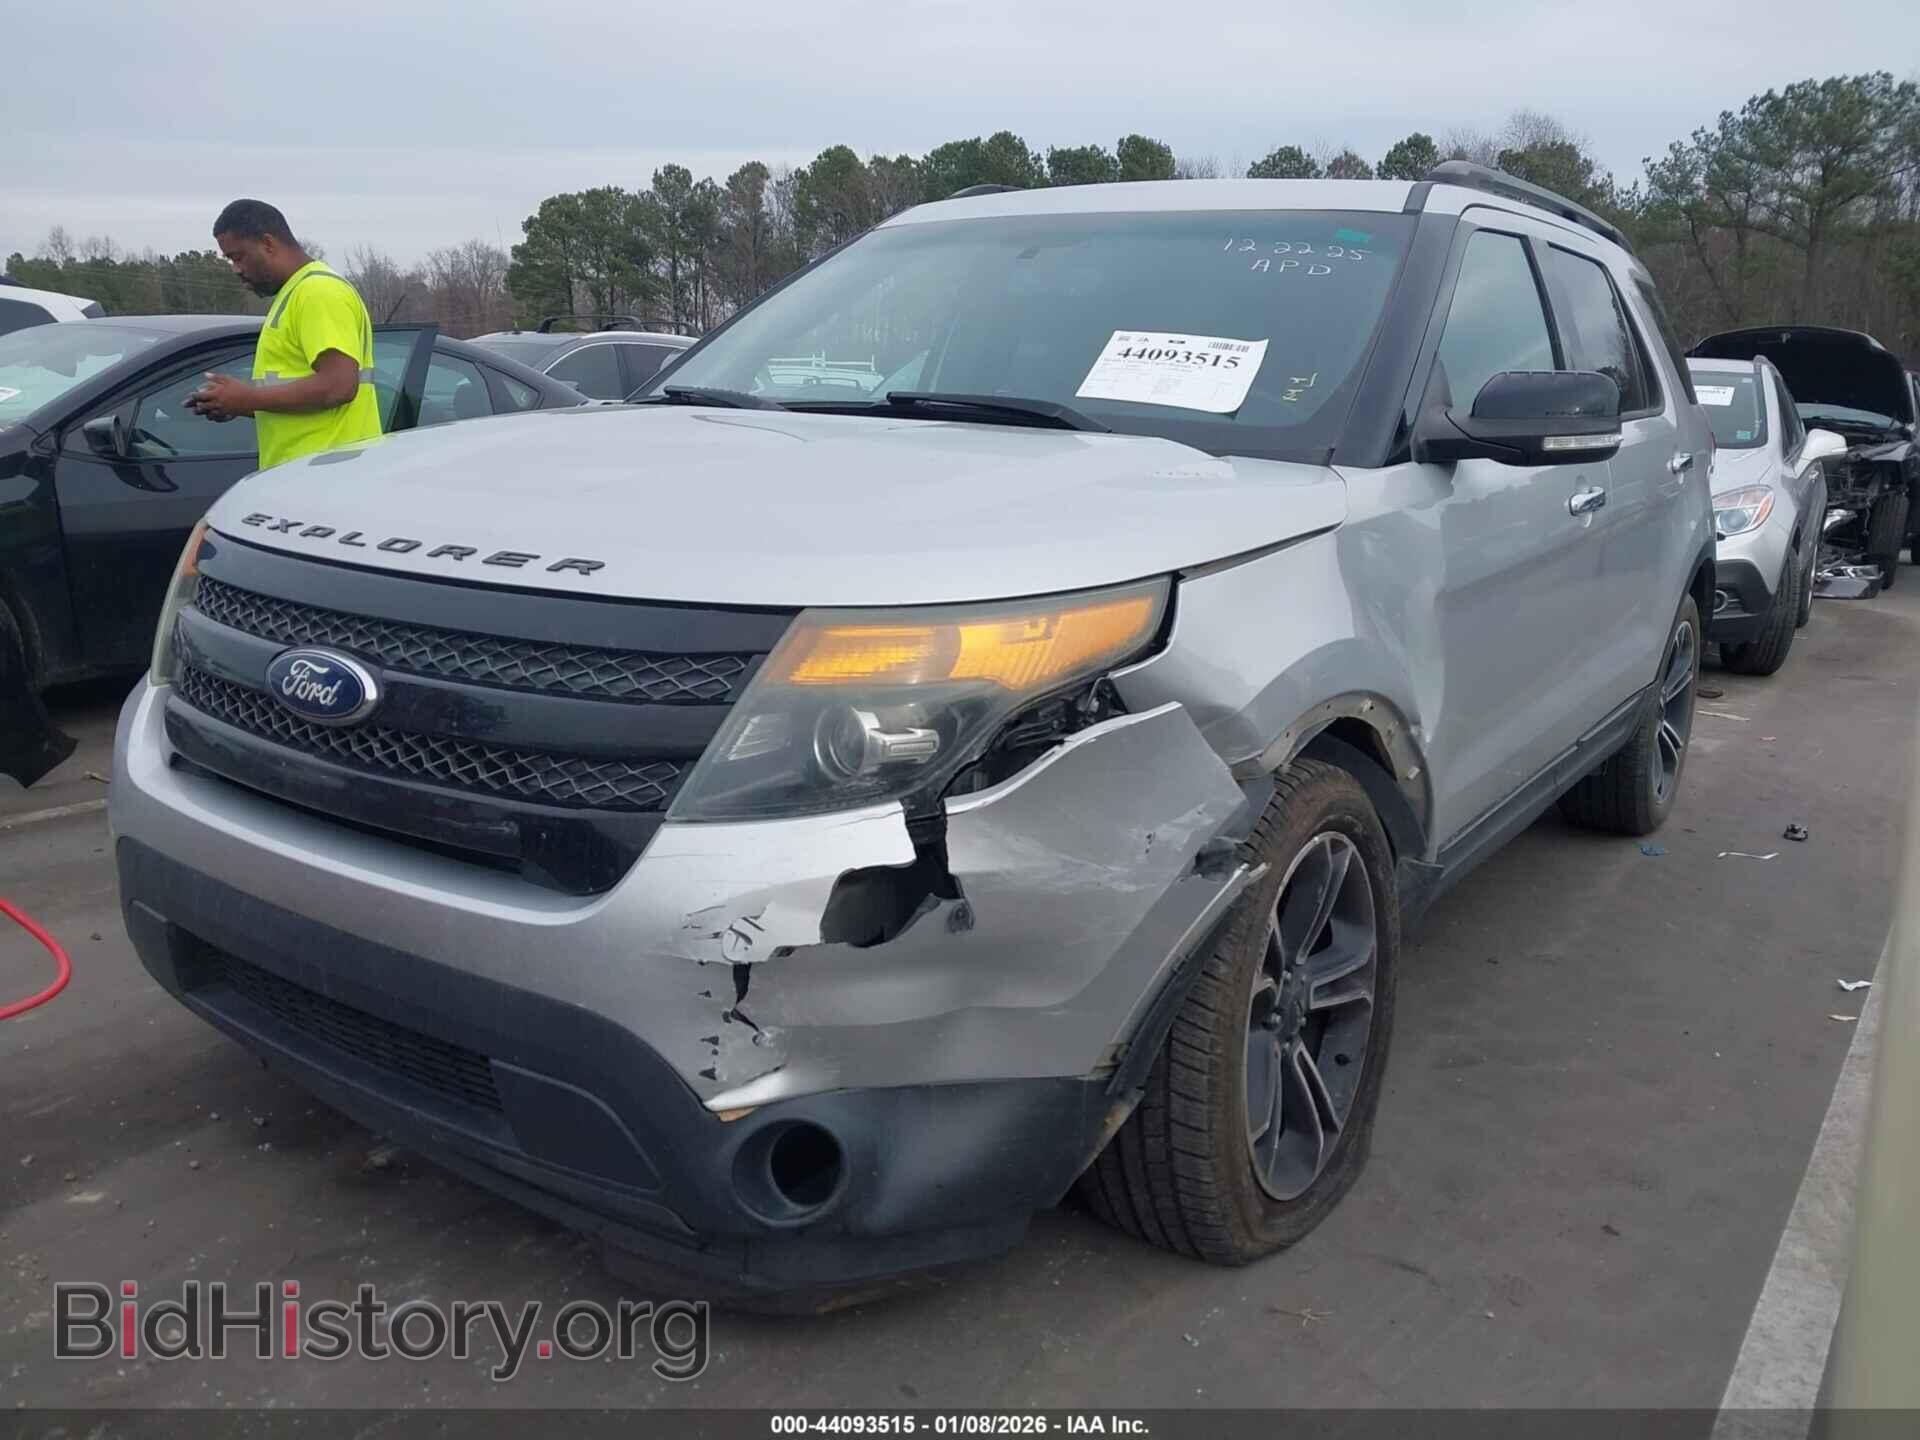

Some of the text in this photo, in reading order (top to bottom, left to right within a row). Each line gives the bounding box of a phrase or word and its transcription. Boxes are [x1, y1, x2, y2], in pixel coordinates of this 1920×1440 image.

[1273, 241, 1316, 254] 22
[1251, 258, 1332, 275] APD
[1117, 347, 1241, 369] 44093515
[241, 512, 606, 576] EXPLORER
[281, 658, 342, 706] Ford
